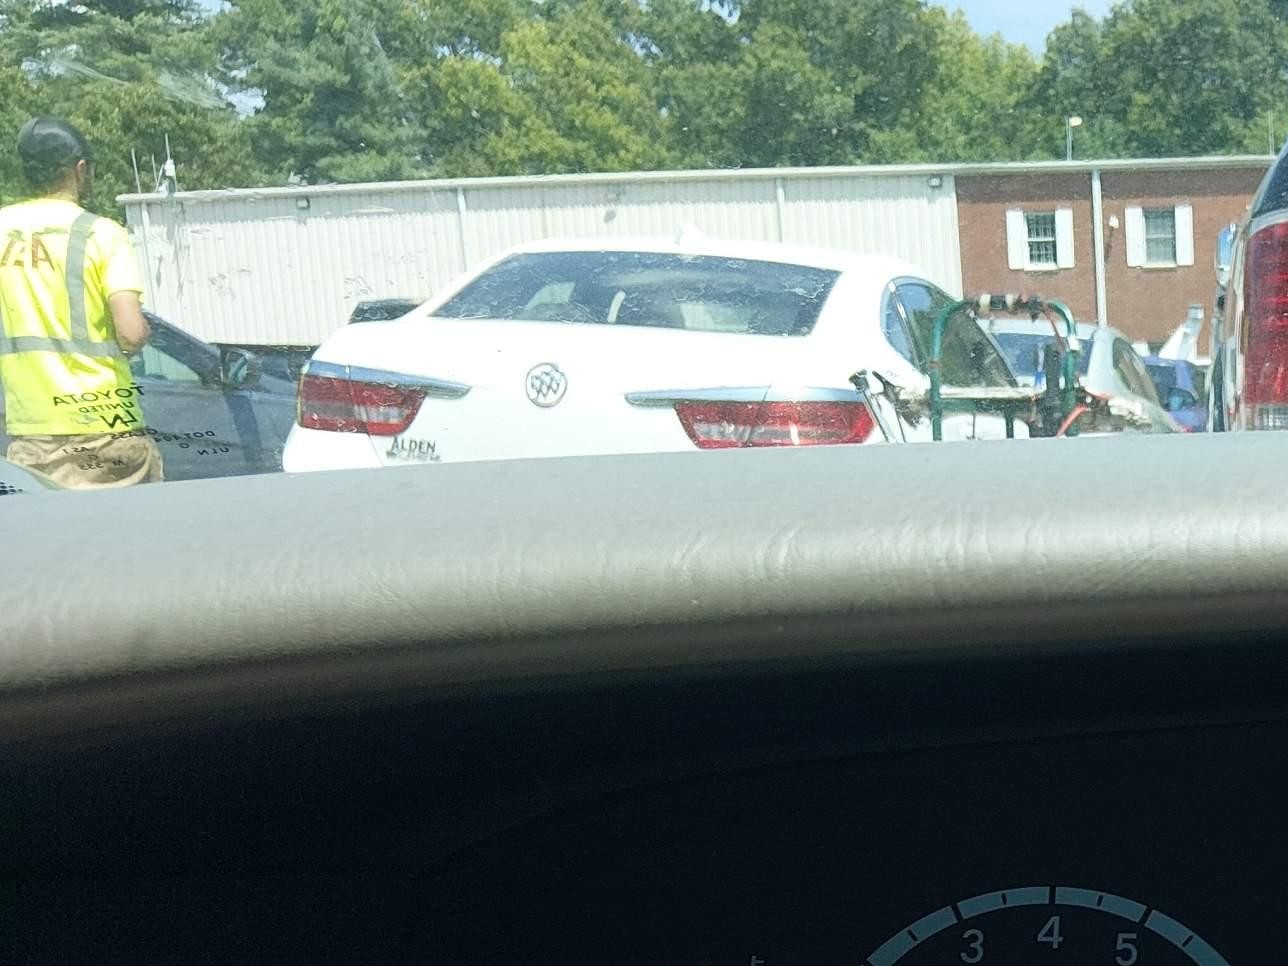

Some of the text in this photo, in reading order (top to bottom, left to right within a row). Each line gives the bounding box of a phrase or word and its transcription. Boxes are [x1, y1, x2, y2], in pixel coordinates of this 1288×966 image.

[961, 929, 983, 963] 3
[1037, 916, 1063, 948] 4
[1116, 933, 1137, 966] 5
